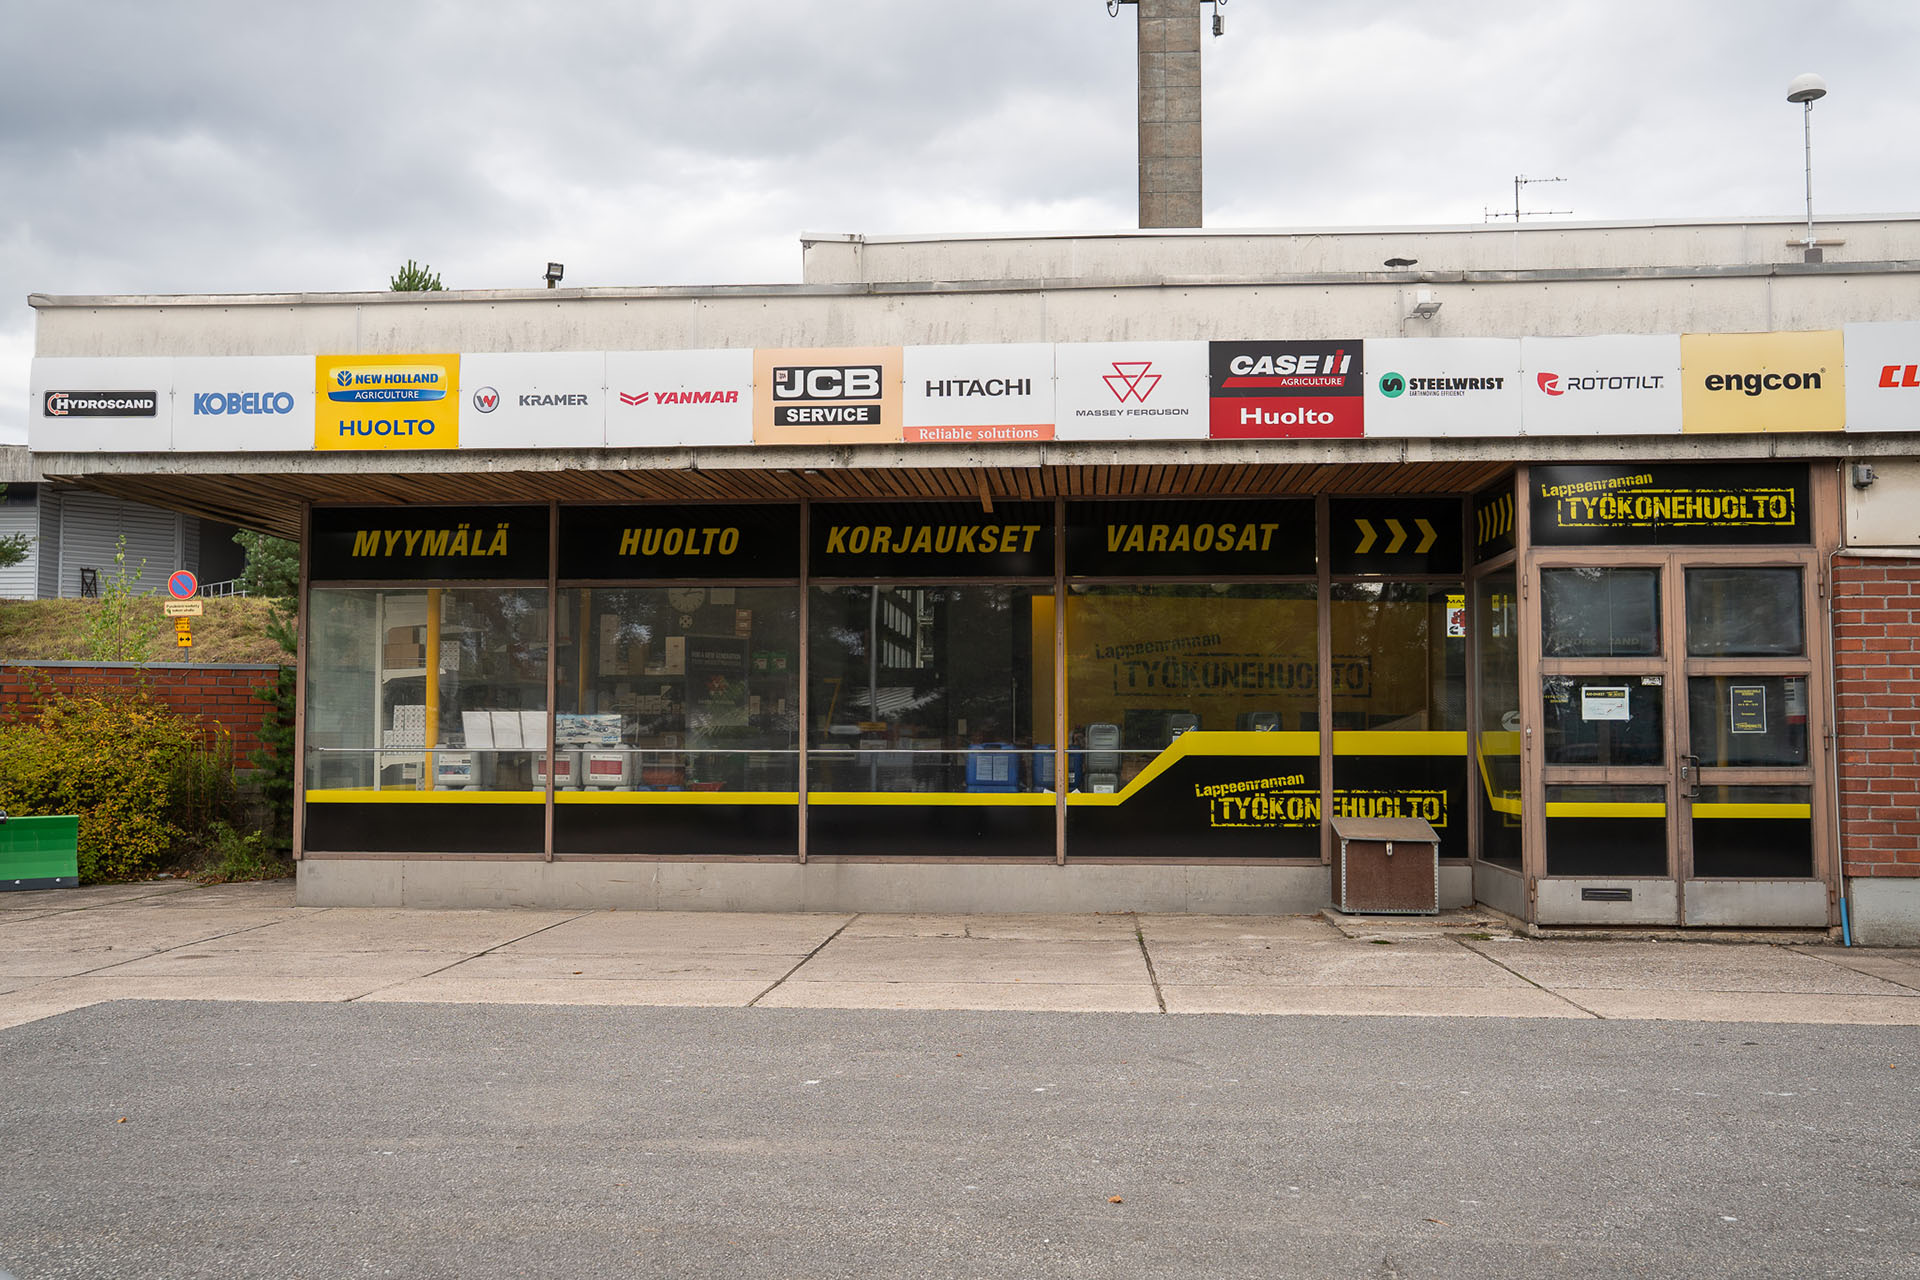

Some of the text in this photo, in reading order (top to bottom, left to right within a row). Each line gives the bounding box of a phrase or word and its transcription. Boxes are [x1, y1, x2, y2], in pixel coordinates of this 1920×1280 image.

[1229, 354, 1320, 376] CASE
[355, 373, 438, 384] NEW HOLLAND
[776, 368, 880, 398] JCB
[925, 378, 1031, 397] HITACHI
[1280, 377, 1342, 386] AGRICULTURE
[1409, 377, 1504, 390] STEELWRIST
[1567, 375, 1664, 390] ROTOTILT
[55, 398, 154, 410] HYDROSCAND
[193, 391, 294, 416] KOBELCO
[354, 390, 420, 400] AGRICULTURE
[519, 394, 589, 407] KRAMER
[654, 390, 739, 405] YANMAR
[786, 407, 868, 423] SERVICE
[1075, 408, 1189, 417] MASSEY FERGUSON
[1240, 407, 1334, 425] Huolto
[339, 419, 435, 436] HUOLTO
[920, 427, 1039, 440] Reliable solutions
[1541, 472, 1653, 499] Lappeenrannan
[1565, 492, 1788, 520] TYÖKONEHUOLTO
[351, 522, 510, 557] MYYMÄLÄ
[618, 527, 740, 556] HUOLTO
[826, 525, 1041, 554] KORJAUKSET
[1106, 523, 1279, 553] VARAOSAT
[1095, 632, 1222, 661] Lappeenrannan
[1194, 773, 1305, 798] Lappeenrannan
